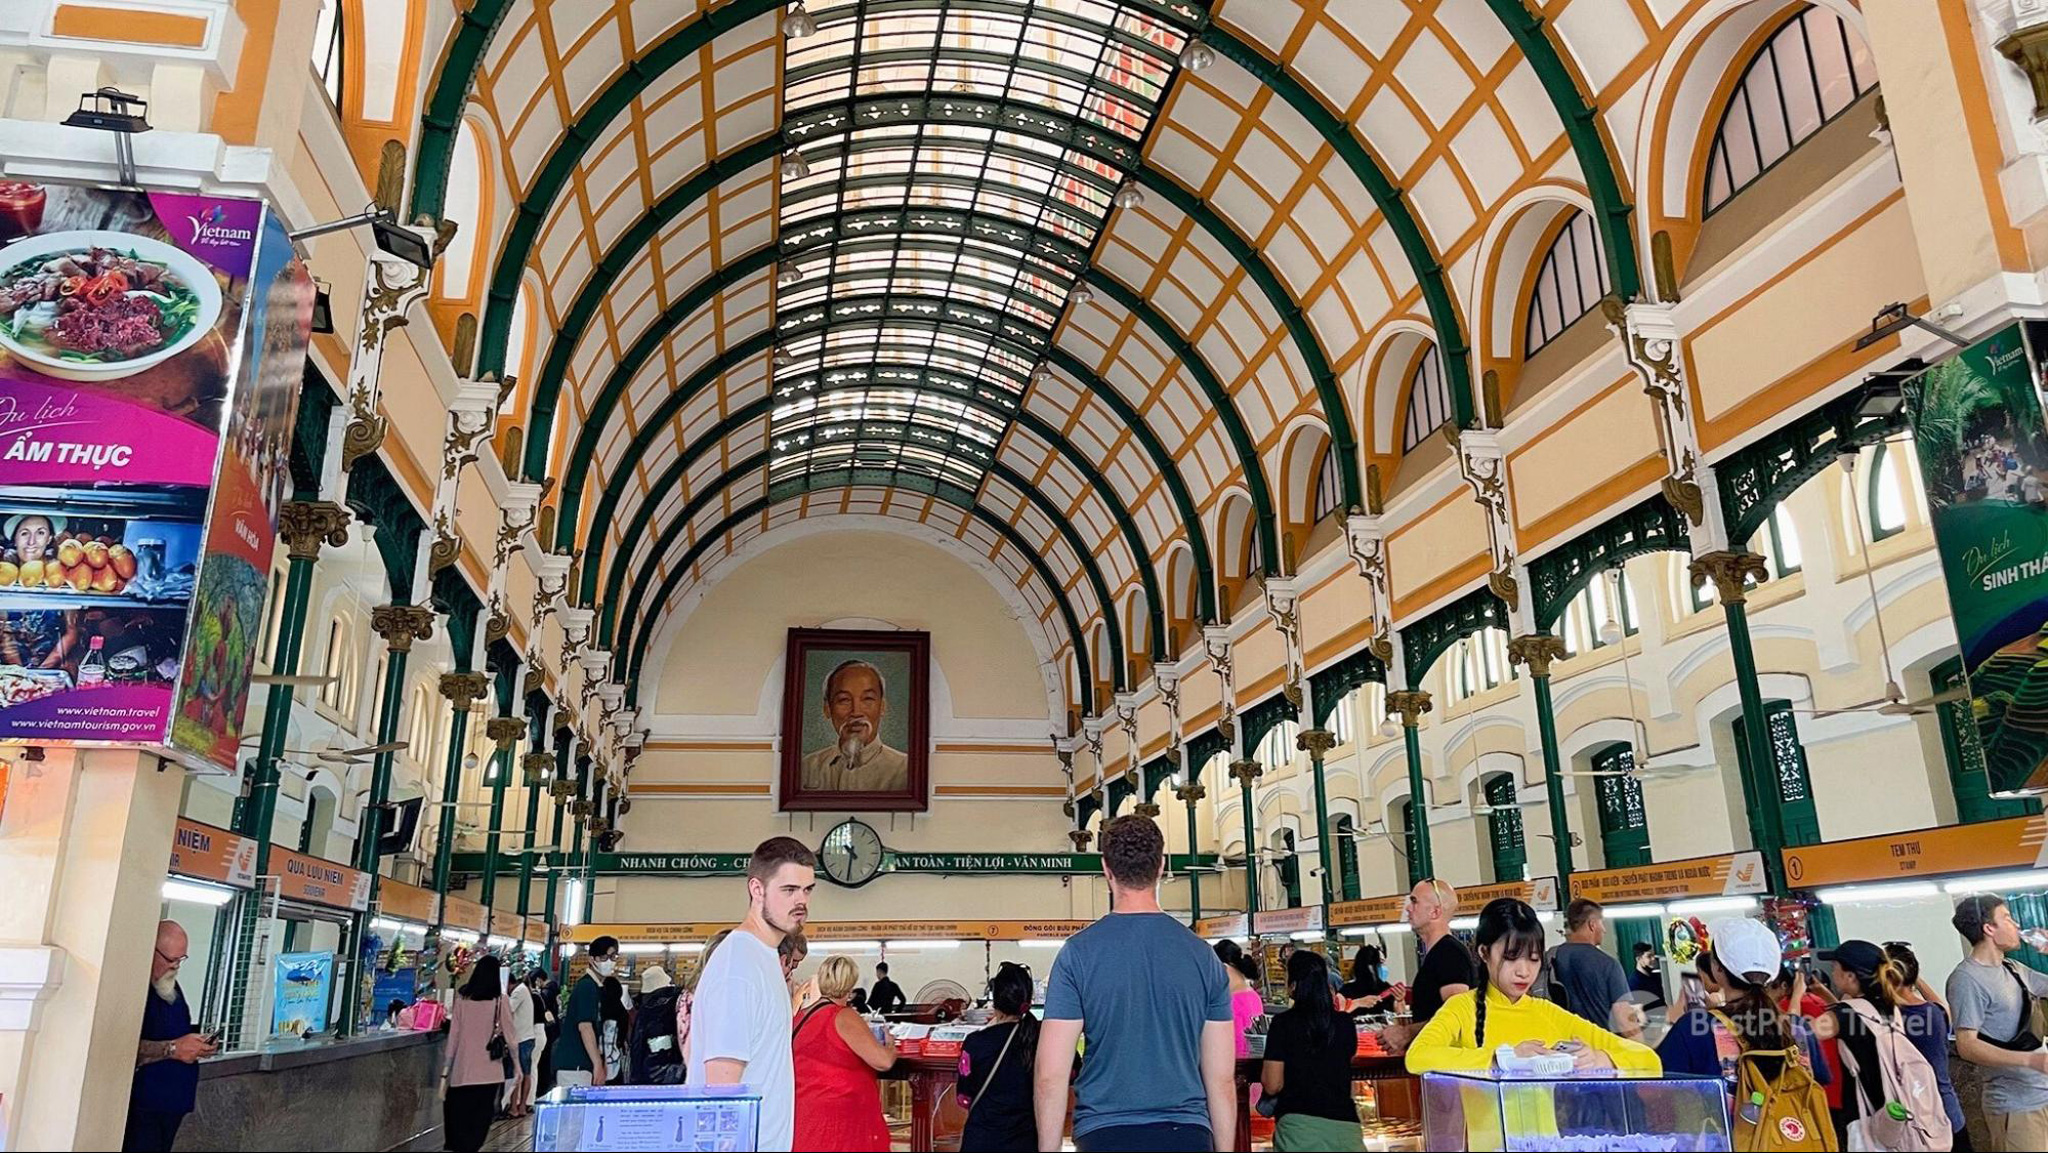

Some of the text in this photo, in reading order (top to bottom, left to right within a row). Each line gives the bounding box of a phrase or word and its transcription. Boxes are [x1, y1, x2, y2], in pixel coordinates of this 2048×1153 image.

[187, 215, 251, 245] Vietnam
[1985, 346, 2024, 376] Vietnam
[34, 393, 80, 424] lịch
[3, 431, 133, 469] ẨM THỰC
[1982, 566, 2018, 591] SINH
[57, 706, 160, 717] www.vietnam.travel
[11, 719, 156, 733] www.vietnamtourism.gov.vn
[178, 828, 211, 855] NIỆM
[620, 857, 666, 868] NHANH
[671, 855, 717, 869] CHÓNG
[895, 857, 910, 868] AN
[914, 855, 945, 868] TOÀN
[955, 855, 982, 870] TIỆN
[1013, 855, 1037, 868] VĂN
[1040, 857, 1072, 868] MINH
